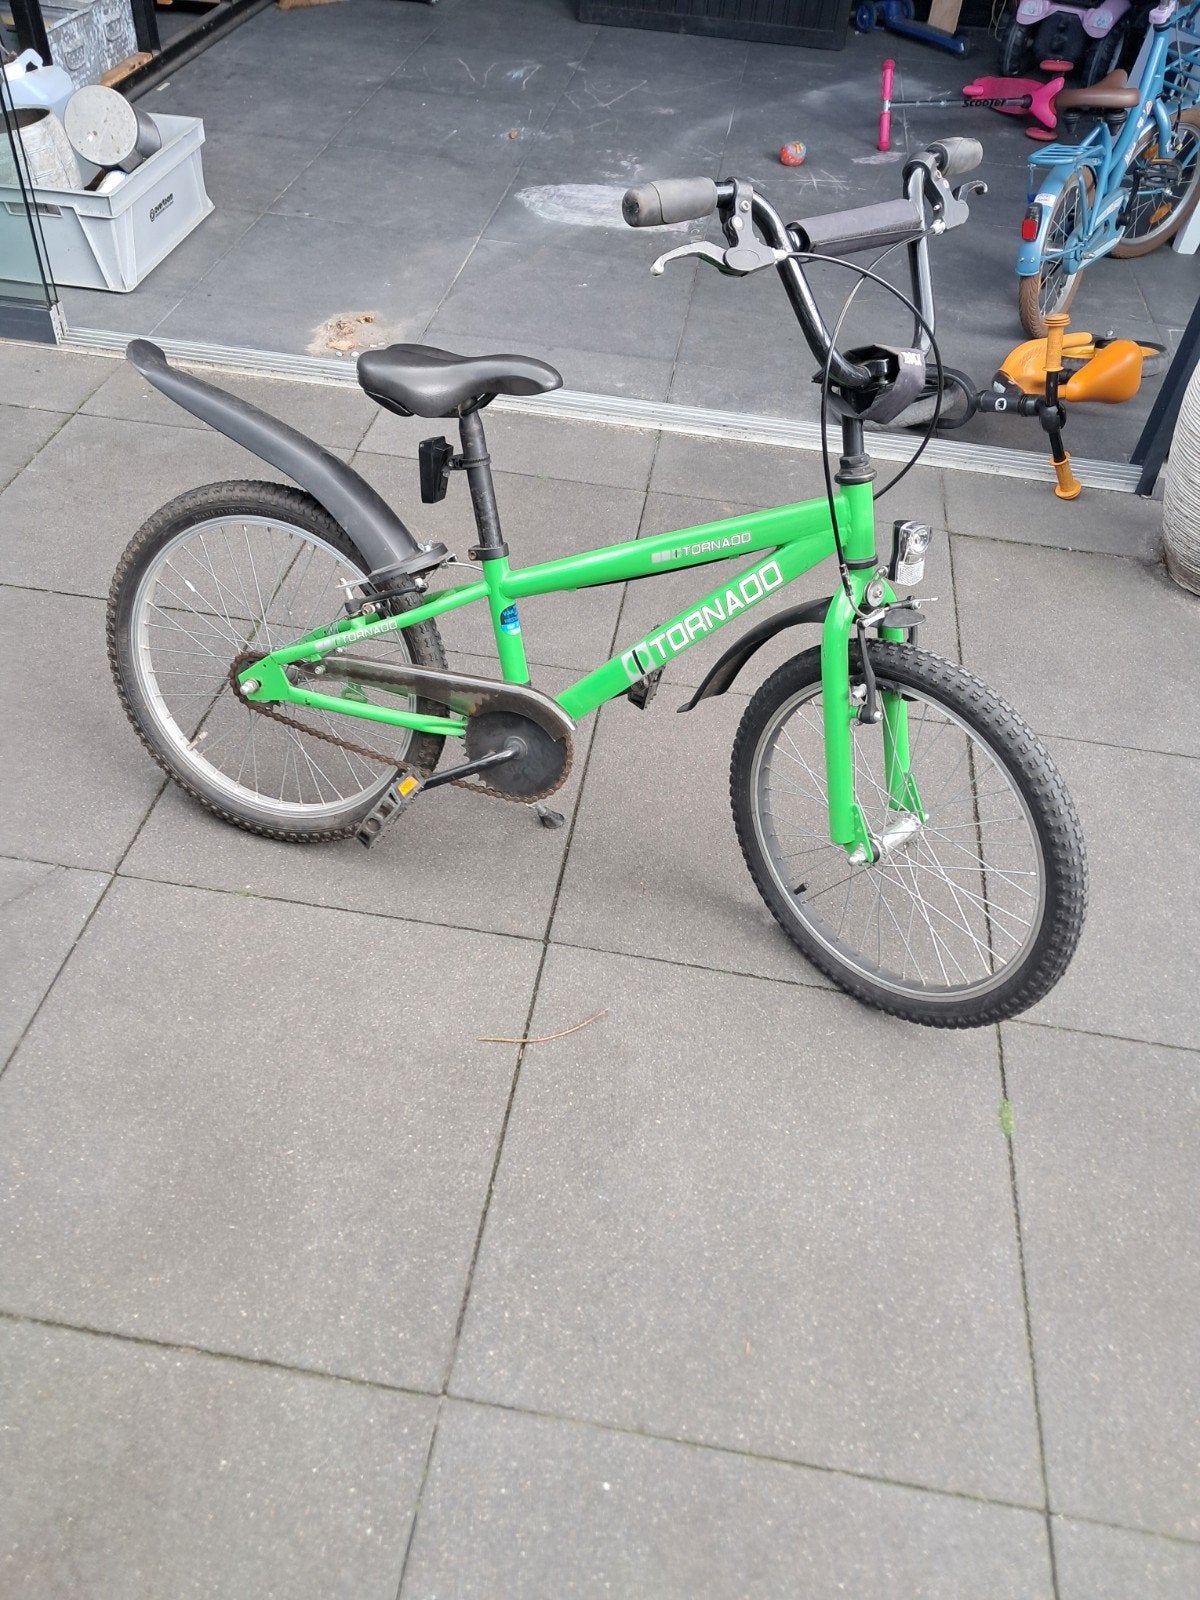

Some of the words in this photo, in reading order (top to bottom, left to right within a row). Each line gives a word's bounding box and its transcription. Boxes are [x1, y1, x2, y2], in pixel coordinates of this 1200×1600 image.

[682, 532, 752, 557] TORNADO
[649, 560, 784, 660] TORNADO
[343, 620, 398, 643] TORNADO
